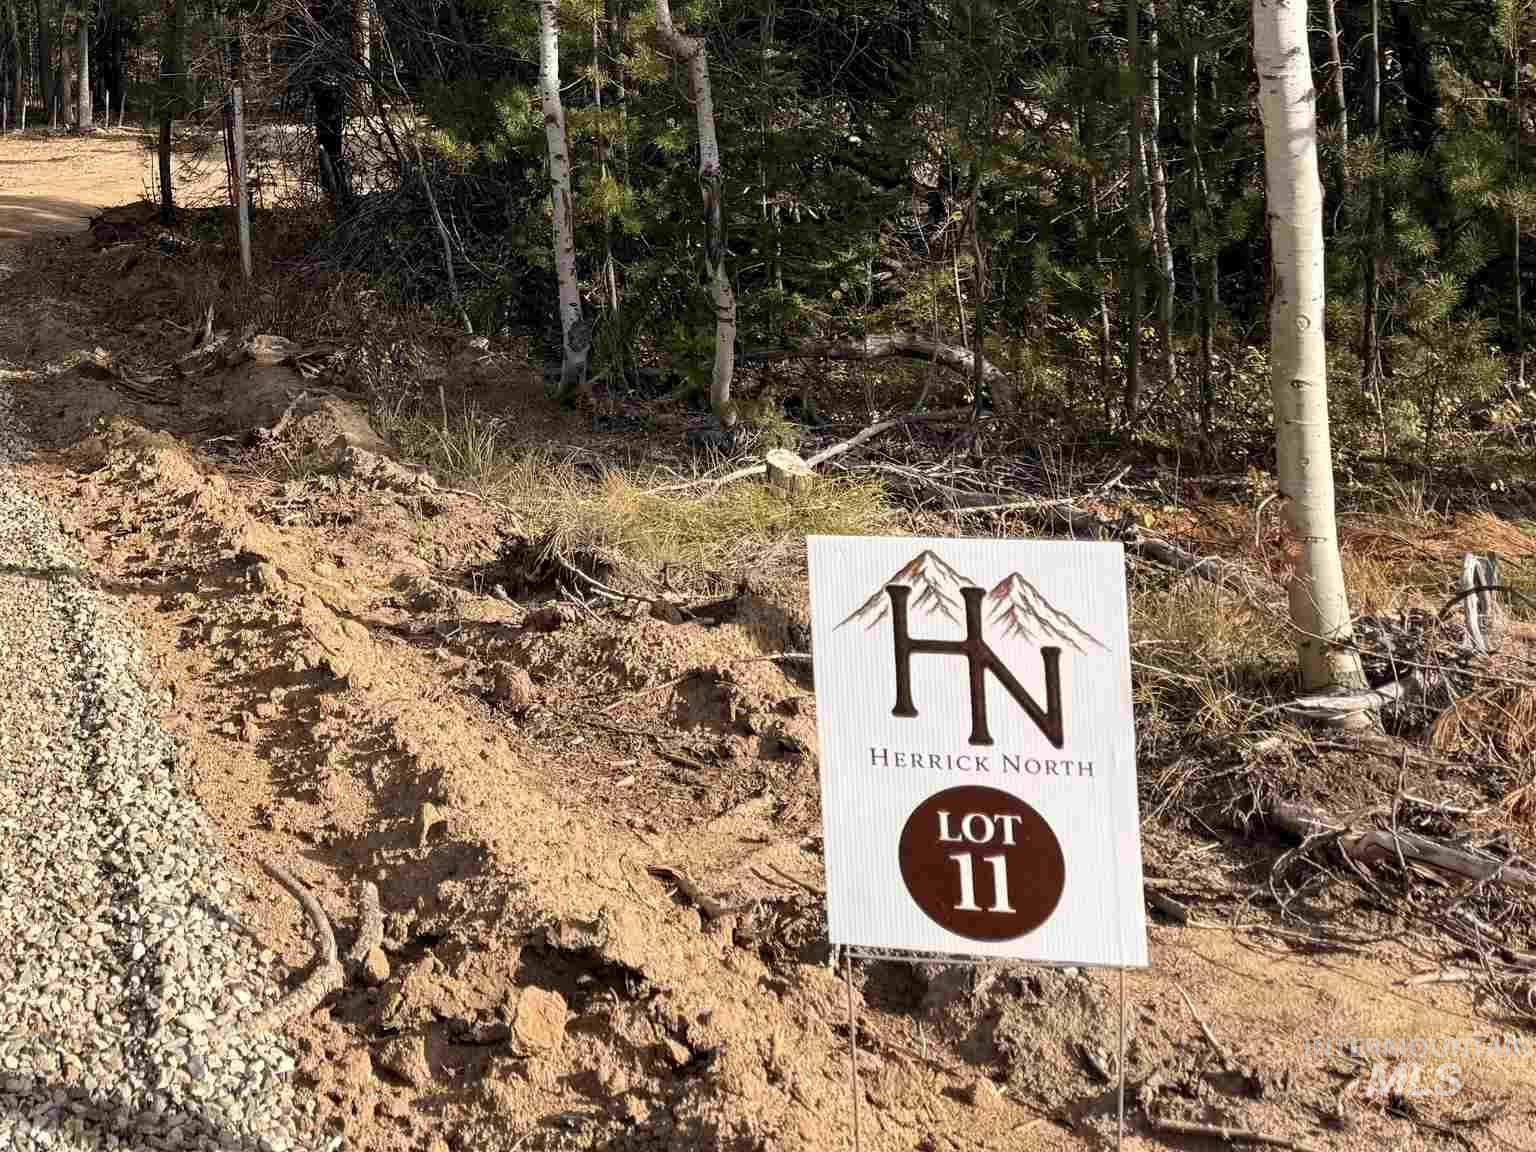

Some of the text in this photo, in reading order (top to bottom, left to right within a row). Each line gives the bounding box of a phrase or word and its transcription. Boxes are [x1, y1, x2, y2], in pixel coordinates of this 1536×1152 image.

[886, 585, 1063, 749] HN
[870, 747, 1095, 778] HERRICK NORTH
[936, 810, 1022, 846] LOT
[949, 852, 1016, 914] 11
